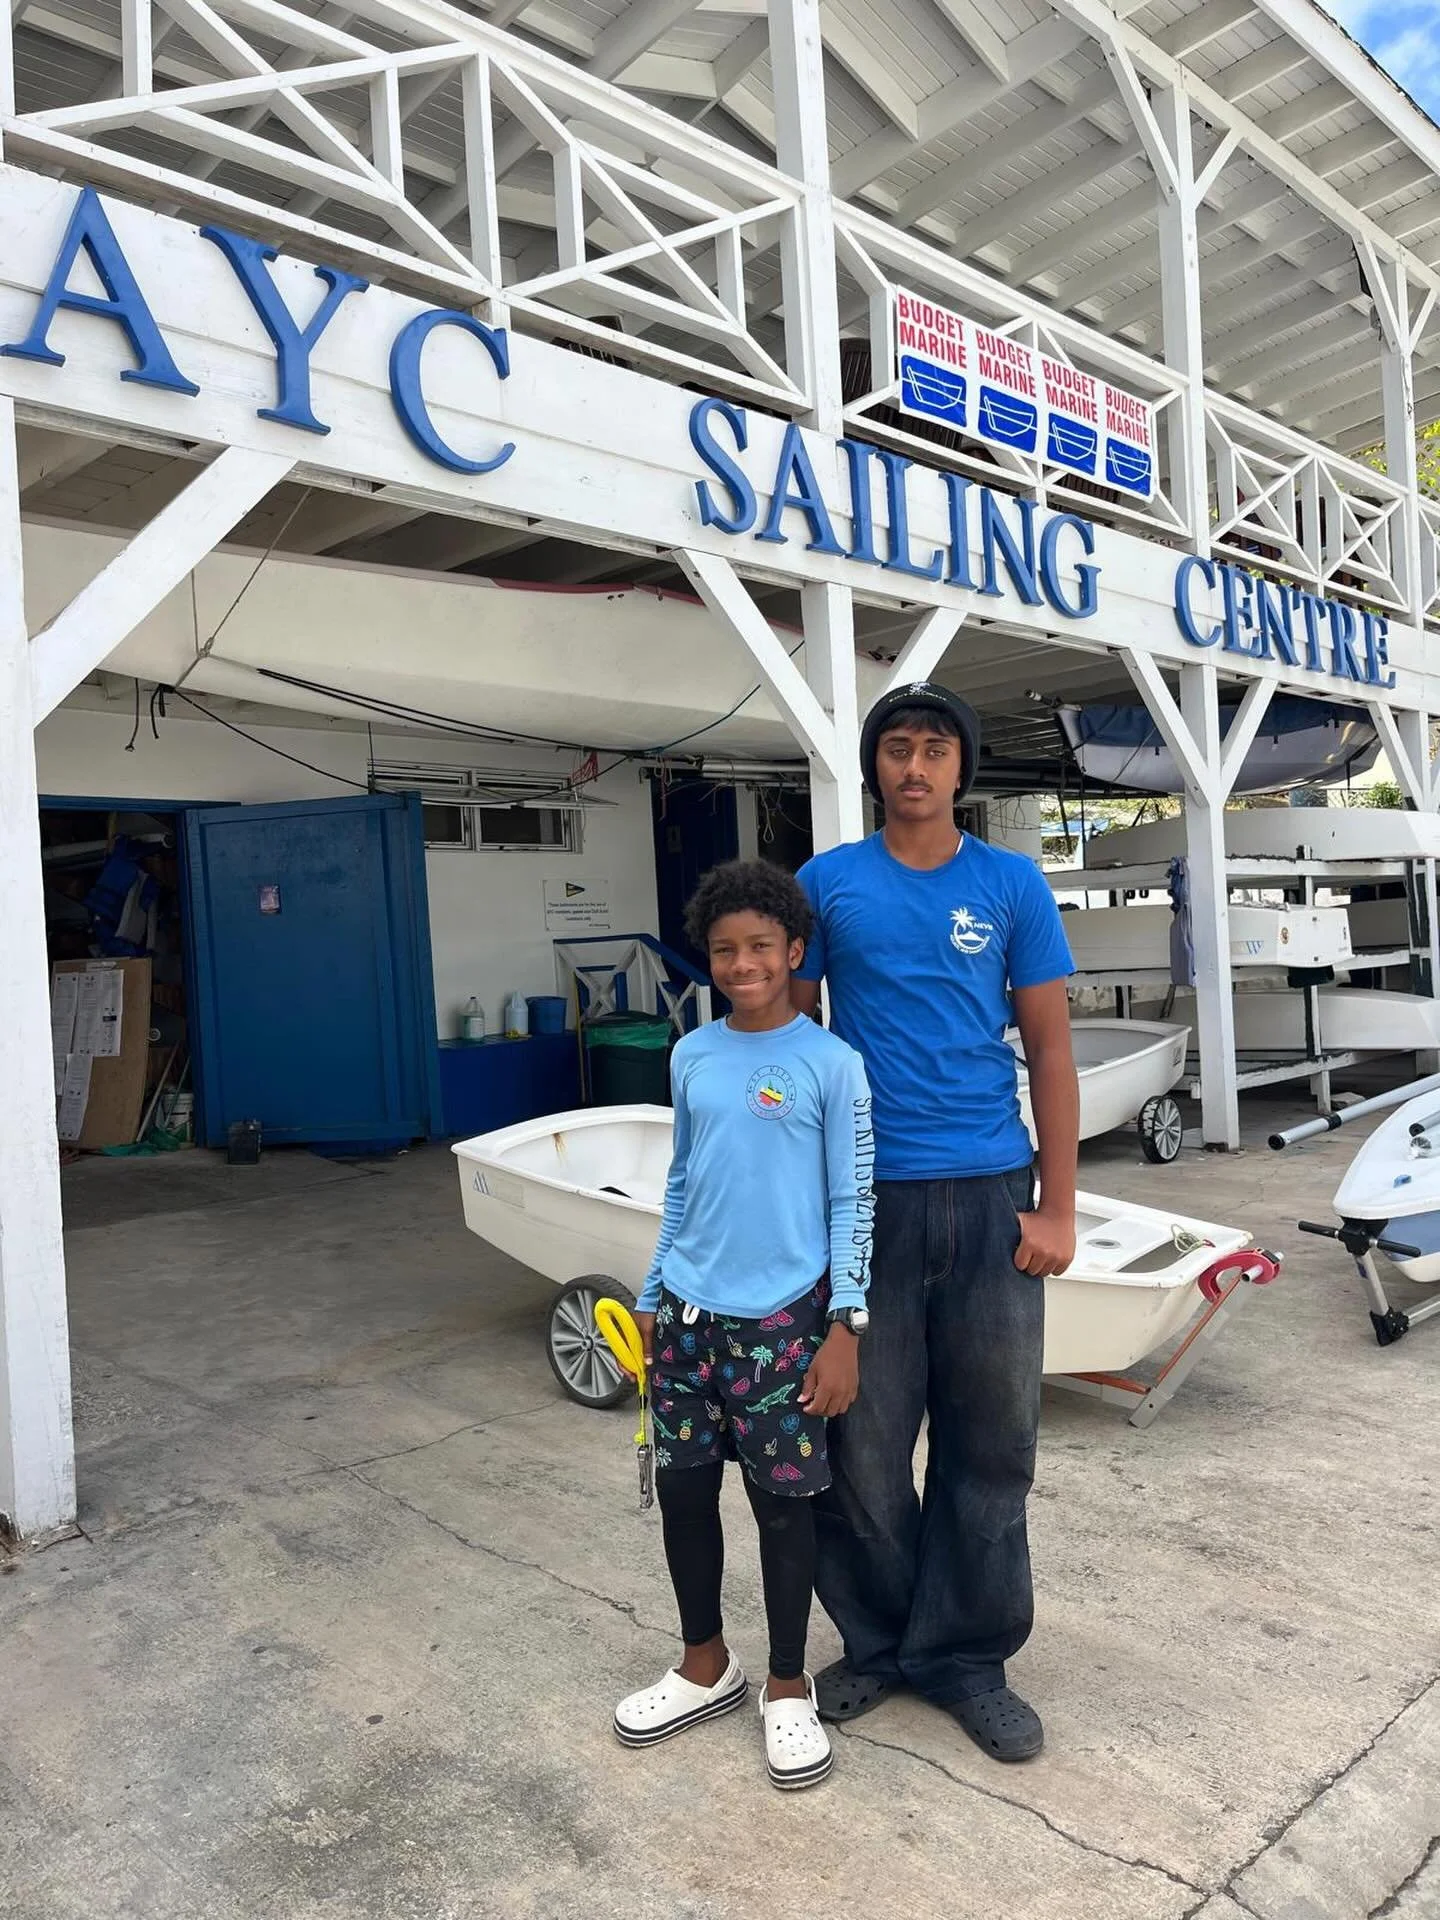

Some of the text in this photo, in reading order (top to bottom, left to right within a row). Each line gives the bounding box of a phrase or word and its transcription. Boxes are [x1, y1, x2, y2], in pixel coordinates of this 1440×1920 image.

[898, 293, 963, 341] BUDGET
[899, 322, 967, 369] MARINE
[976, 330, 1032, 372] BUDGET
[979, 354, 1037, 398] MARINE
[1042, 359, 1096, 399] BUDGET
[1045, 383, 1098, 423] MARINE
[1105, 387, 1147, 425] BUDGET
[0, 185, 1396, 689] AYC SAILING CENTRE
[1106, 412, 1150, 447] MARINE
